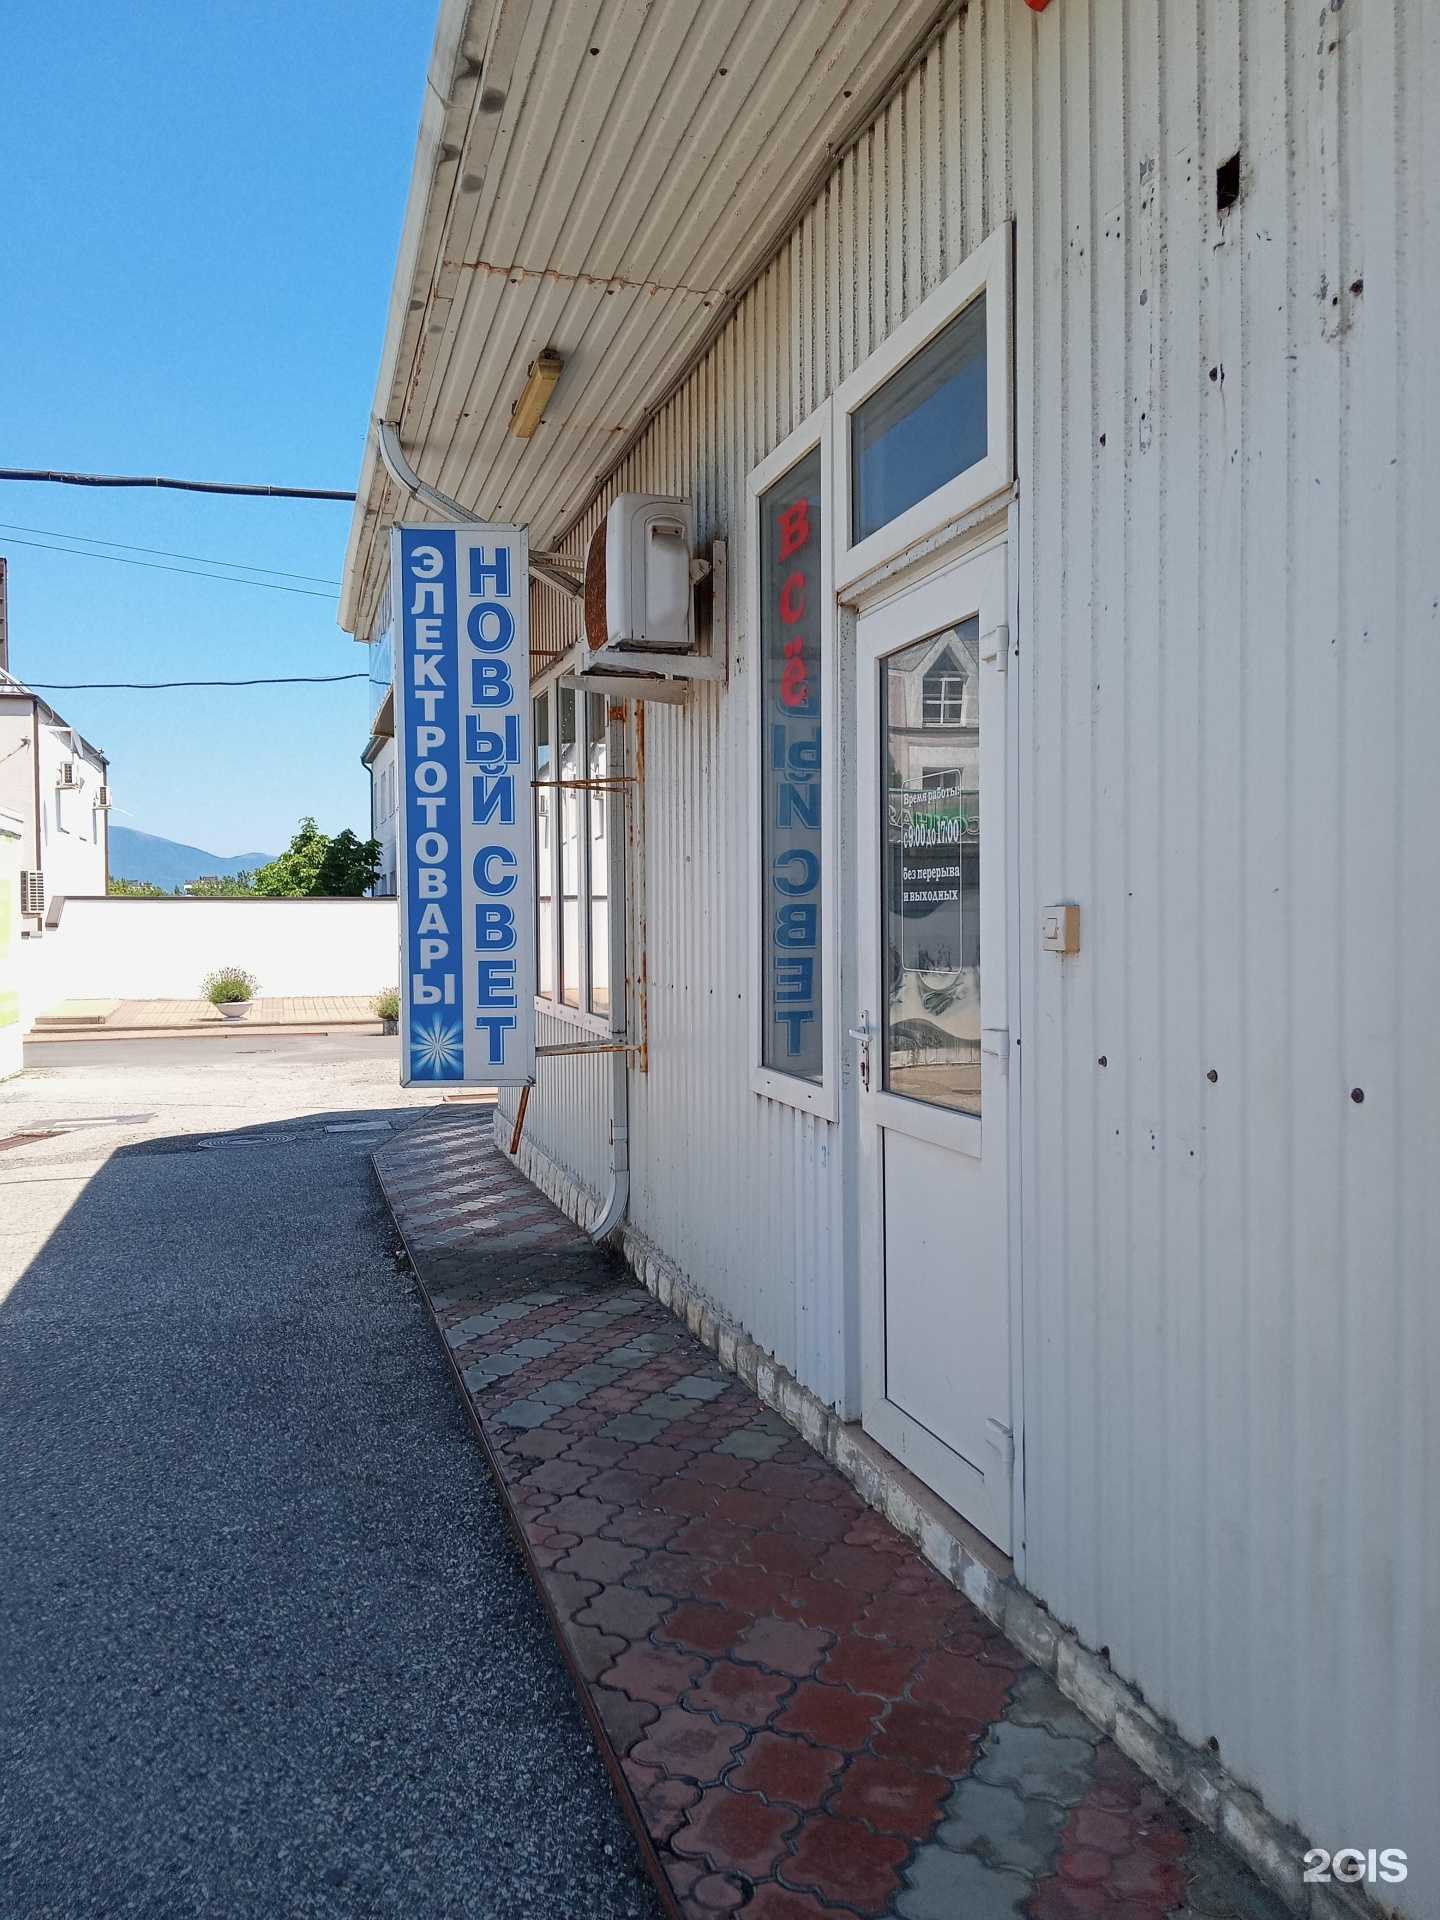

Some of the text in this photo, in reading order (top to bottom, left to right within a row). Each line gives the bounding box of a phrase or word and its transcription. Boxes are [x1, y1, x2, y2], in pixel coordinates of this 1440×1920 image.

[410, 545, 456, 1006] ЭЛЕКТРОТОВАРЫ
[464, 545, 521, 1066] НОВЫЙ СВЕТ
[903, 792, 928, 807] Время
[936, 819, 960, 843] 17:00
[903, 866, 960, 882] без перерыва
[903, 889, 959, 903] и выходных
